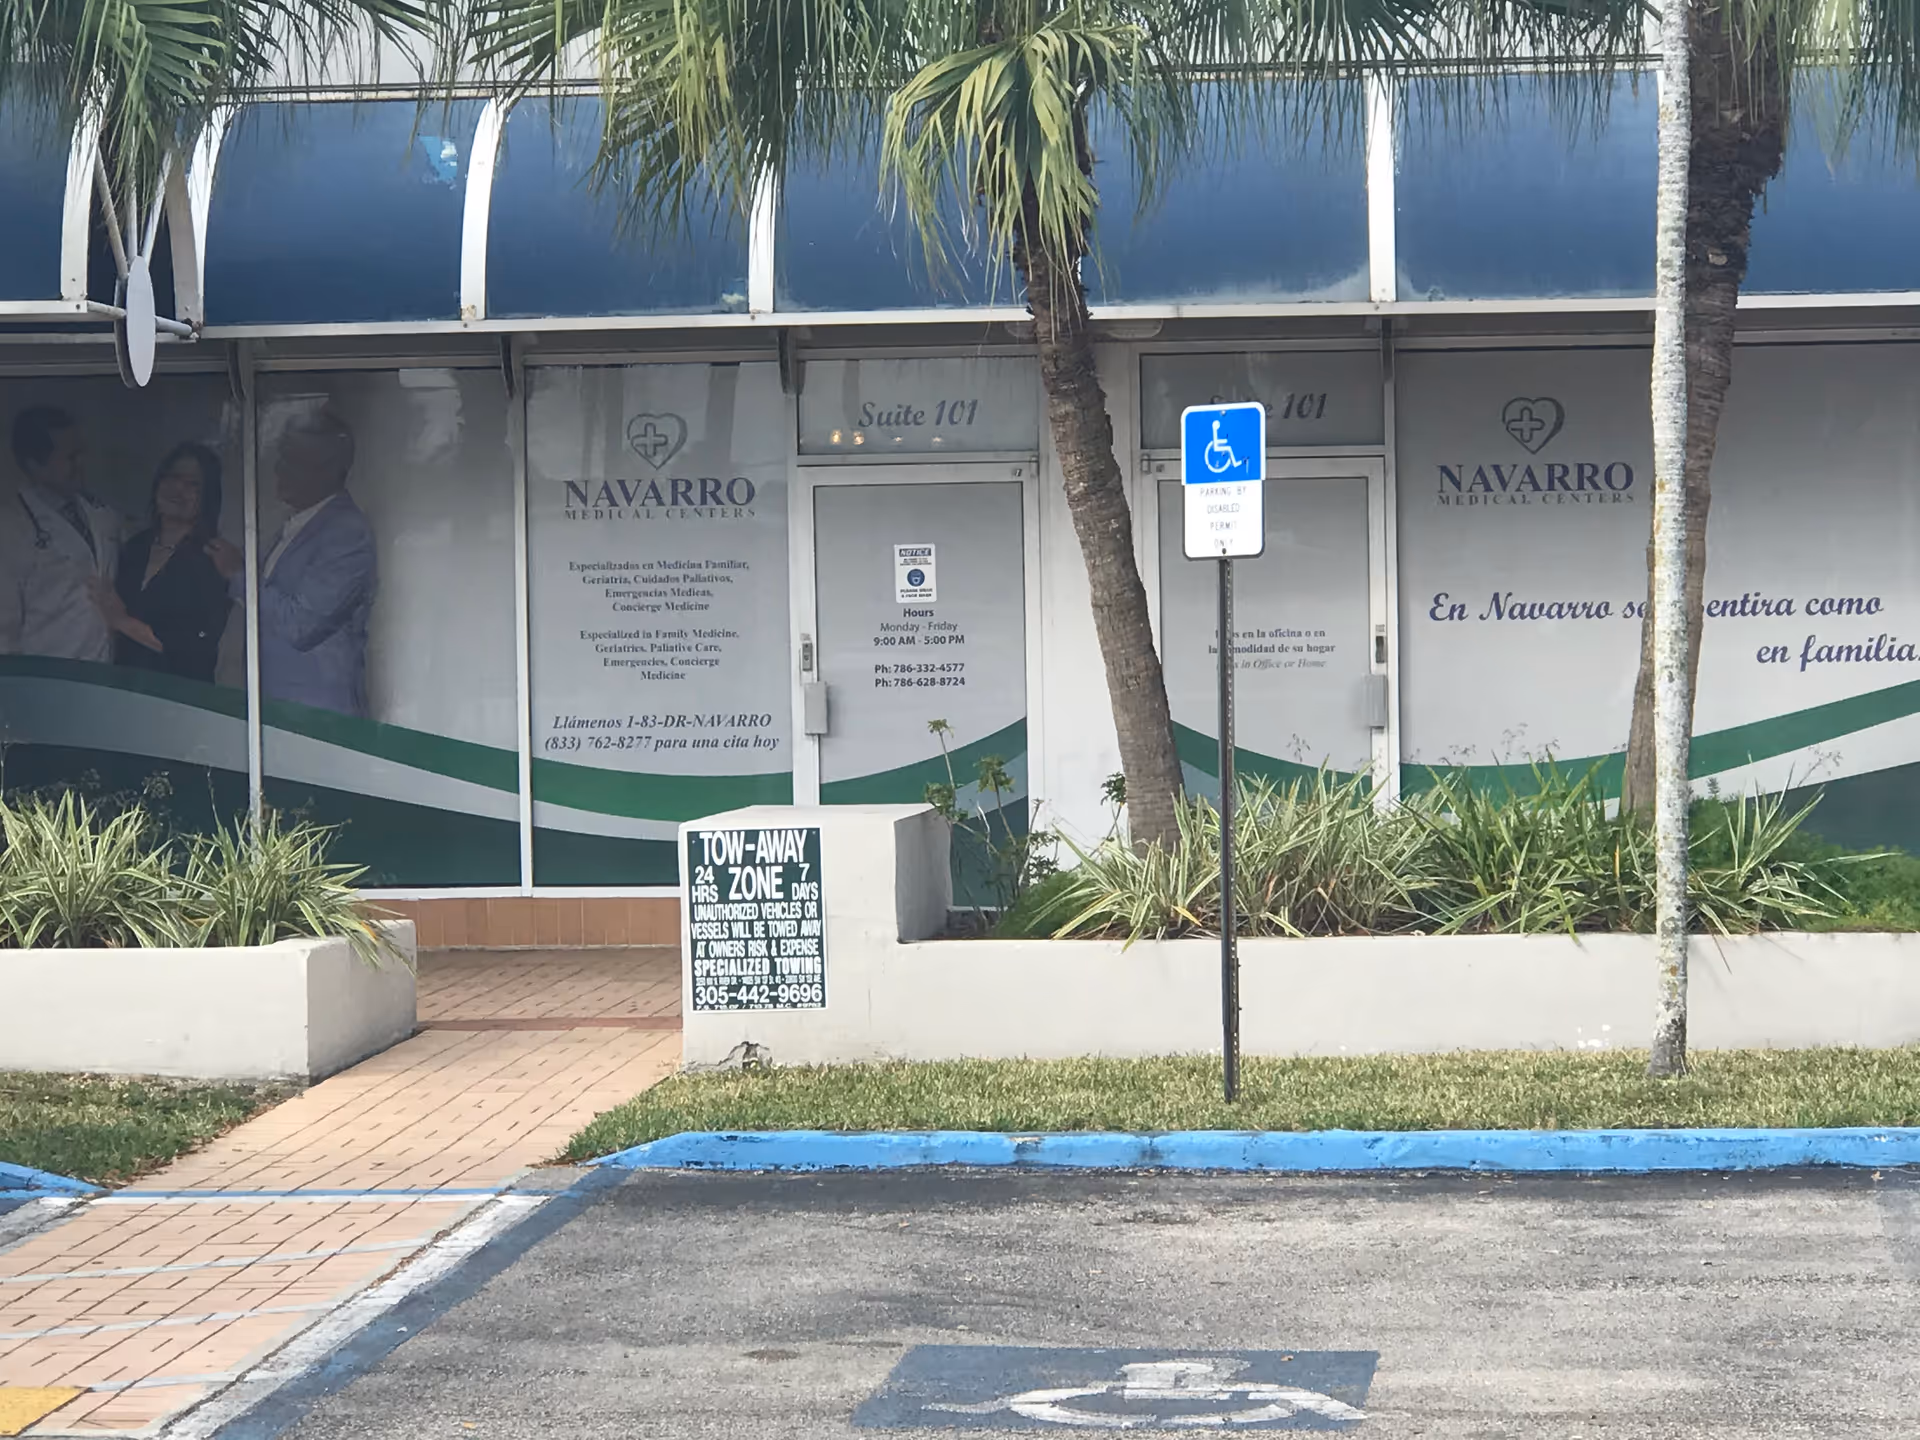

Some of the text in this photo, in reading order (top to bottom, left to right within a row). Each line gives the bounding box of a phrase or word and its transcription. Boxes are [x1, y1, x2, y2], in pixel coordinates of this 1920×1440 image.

[1283, 393, 1327, 419] 101
[858, 399, 978, 427] Suite 101
[1437, 461, 1634, 493] NAVARRO
[563, 477, 756, 508] NAVARRO
[1200, 486, 1246, 496] PARKING BY
[1437, 493, 1634, 506] MEDICAL CENTERS
[565, 508, 756, 520] MEDICAL CENTERS
[1207, 503, 1240, 514] DISABLED
[1210, 520, 1237, 530] PERMIT
[1214, 538, 1233, 548] ONY
[569, 561, 640, 572] Especializados
[657, 560, 702, 570] Medicina
[705, 560, 749, 571] Familiar,
[634, 575, 680, 584] Cuidados
[683, 574, 733, 584] Paliativos,
[605, 589, 667, 599] Emergencias
[612, 601, 709, 613] Concierge Medicine
[903, 608, 934, 617] Hours
[1429, 592, 1469, 621] En
[1479, 592, 1614, 620] Navarro
[1702, 592, 1797, 618] entira
[1805, 596, 1885, 616] como
[880, 622, 919, 632] Monday
[928, 621, 958, 632] Friday
[580, 630, 639, 641] Especialized
[642, 630, 652, 639] in
[655, 629, 688, 640] Family
[1257, 629, 1266, 638] la
[1269, 629, 1301, 638] oficina
[873, 636, 896, 646] 9:00
[898, 635, 915, 645] AM
[924, 635, 946, 644] 5:00
[948, 635, 965, 644] PM
[650, 643, 692, 653] Paliative
[1208, 645, 1217, 654] la
[1278, 644, 1289, 653] de
[1293, 645, 1304, 653] su
[1307, 644, 1336, 655] hogar
[1756, 645, 1790, 663] en
[670, 657, 719, 667] Concierge
[875, 663, 965, 673] Ph: 786-332-4577
[1254, 659, 1280, 670] Office
[1298, 659, 1326, 668] Home
[640, 671, 686, 680] Medicine
[875, 677, 965, 687] Ph: 786-628-8724
[552, 714, 772, 729] Llámenos 1-83-DR-NAVARRO
[545, 735, 779, 752] (833) 762-8277 para una cita hoy
[699, 829, 808, 866] TOW-AWAY
[695, 865, 714, 884] 24
[799, 863, 810, 881] 7
[728, 865, 784, 901] ZONE
[692, 884, 719, 903] HRS
[791, 882, 818, 901] DAYS
[694, 901, 818, 921] UNAUTHORIZED VEHICLES OR
[691, 920, 822, 940] VESSELS WILL BE TOWED AWAY
[696, 939, 819, 958] AT OWNERS RISK & EXPENSE
[694, 956, 822, 977] SPECIALIZED TOWING
[695, 984, 823, 1005] 305-442-9696
